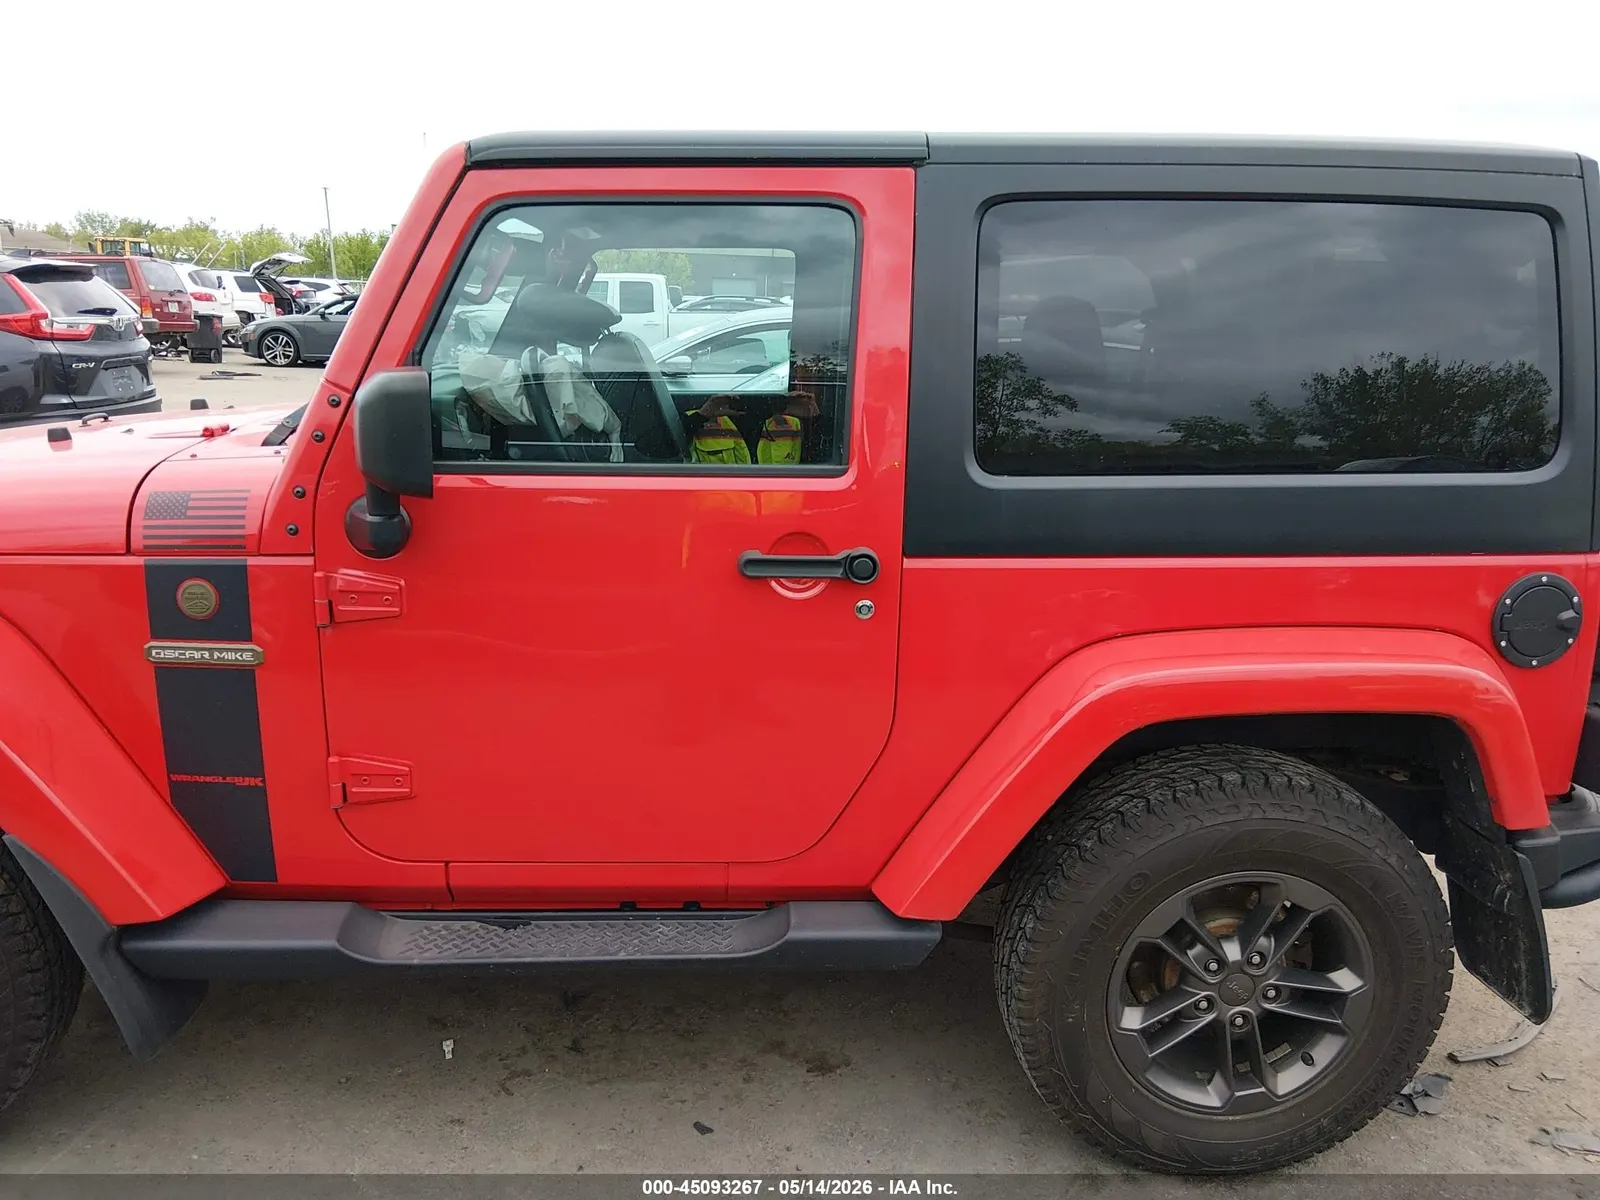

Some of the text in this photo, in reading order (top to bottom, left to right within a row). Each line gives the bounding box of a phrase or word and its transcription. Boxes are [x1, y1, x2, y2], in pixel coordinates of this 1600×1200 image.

[72, 361, 95, 369] CR-V
[151, 649, 255, 661] OSCAR MIKE
[1226, 979, 1249, 1000] Jeep
